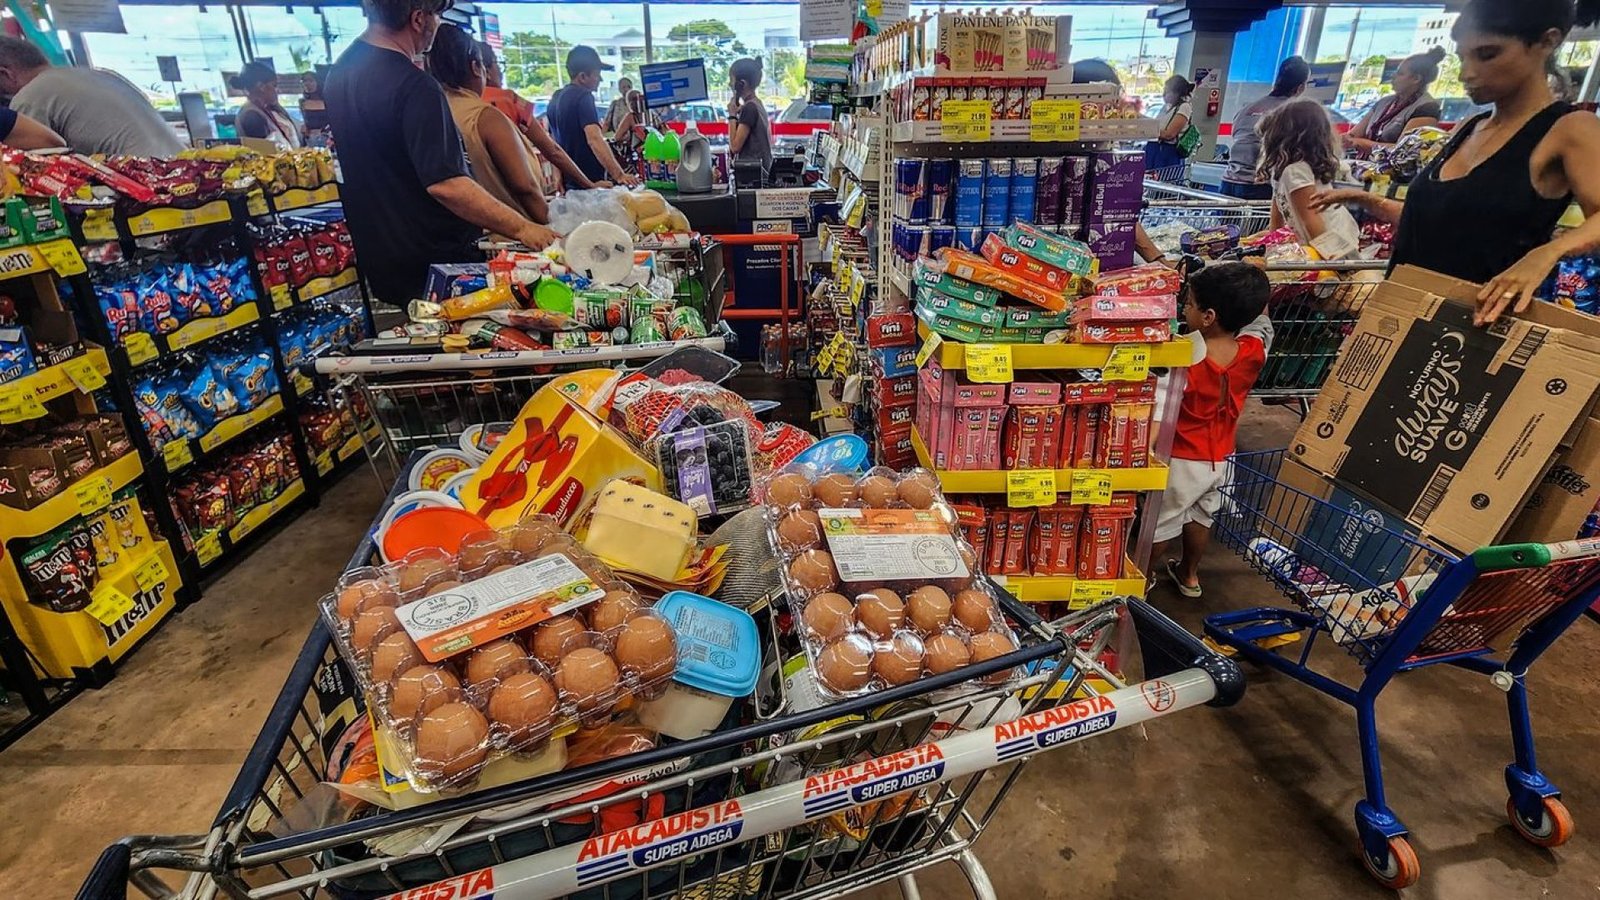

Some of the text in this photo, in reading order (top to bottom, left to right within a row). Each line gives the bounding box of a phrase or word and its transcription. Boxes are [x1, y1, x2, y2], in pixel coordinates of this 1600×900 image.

[953, 17, 1003, 27] PANTENE
[1005, 16, 1055, 26] PANTENE
[1094, 184, 1105, 215] Red Bull
[1018, 235, 1037, 248] fini
[1001, 253, 1019, 265] fini
[923, 272, 941, 283] fini
[882, 322, 901, 334] fini
[1012, 312, 1030, 322] fini
[897, 351, 916, 362] fini
[894, 381, 912, 391] fini
[1409, 349, 1443, 399] NOTURNO
[892, 408, 909, 419] fini
[1394, 353, 1462, 456] always
[1463, 391, 1493, 433] ABSORVENTE
[1316, 421, 1335, 439] G
[1410, 400, 1460, 464] SUAVE
[1470, 407, 1489, 433] GRANDE
[1444, 430, 1468, 451] G
[1345, 531, 1364, 559] SUAVE
[994, 696, 1116, 743] ATACADISTA
[1044, 716, 1111, 747] SUPER ADEGA
[803, 742, 944, 798] ATACADISTA
[860, 768, 938, 801] SUPER ADEGA
[576, 798, 745, 863] ATACADISTA
[643, 826, 734, 865] SUPER ADEGA
